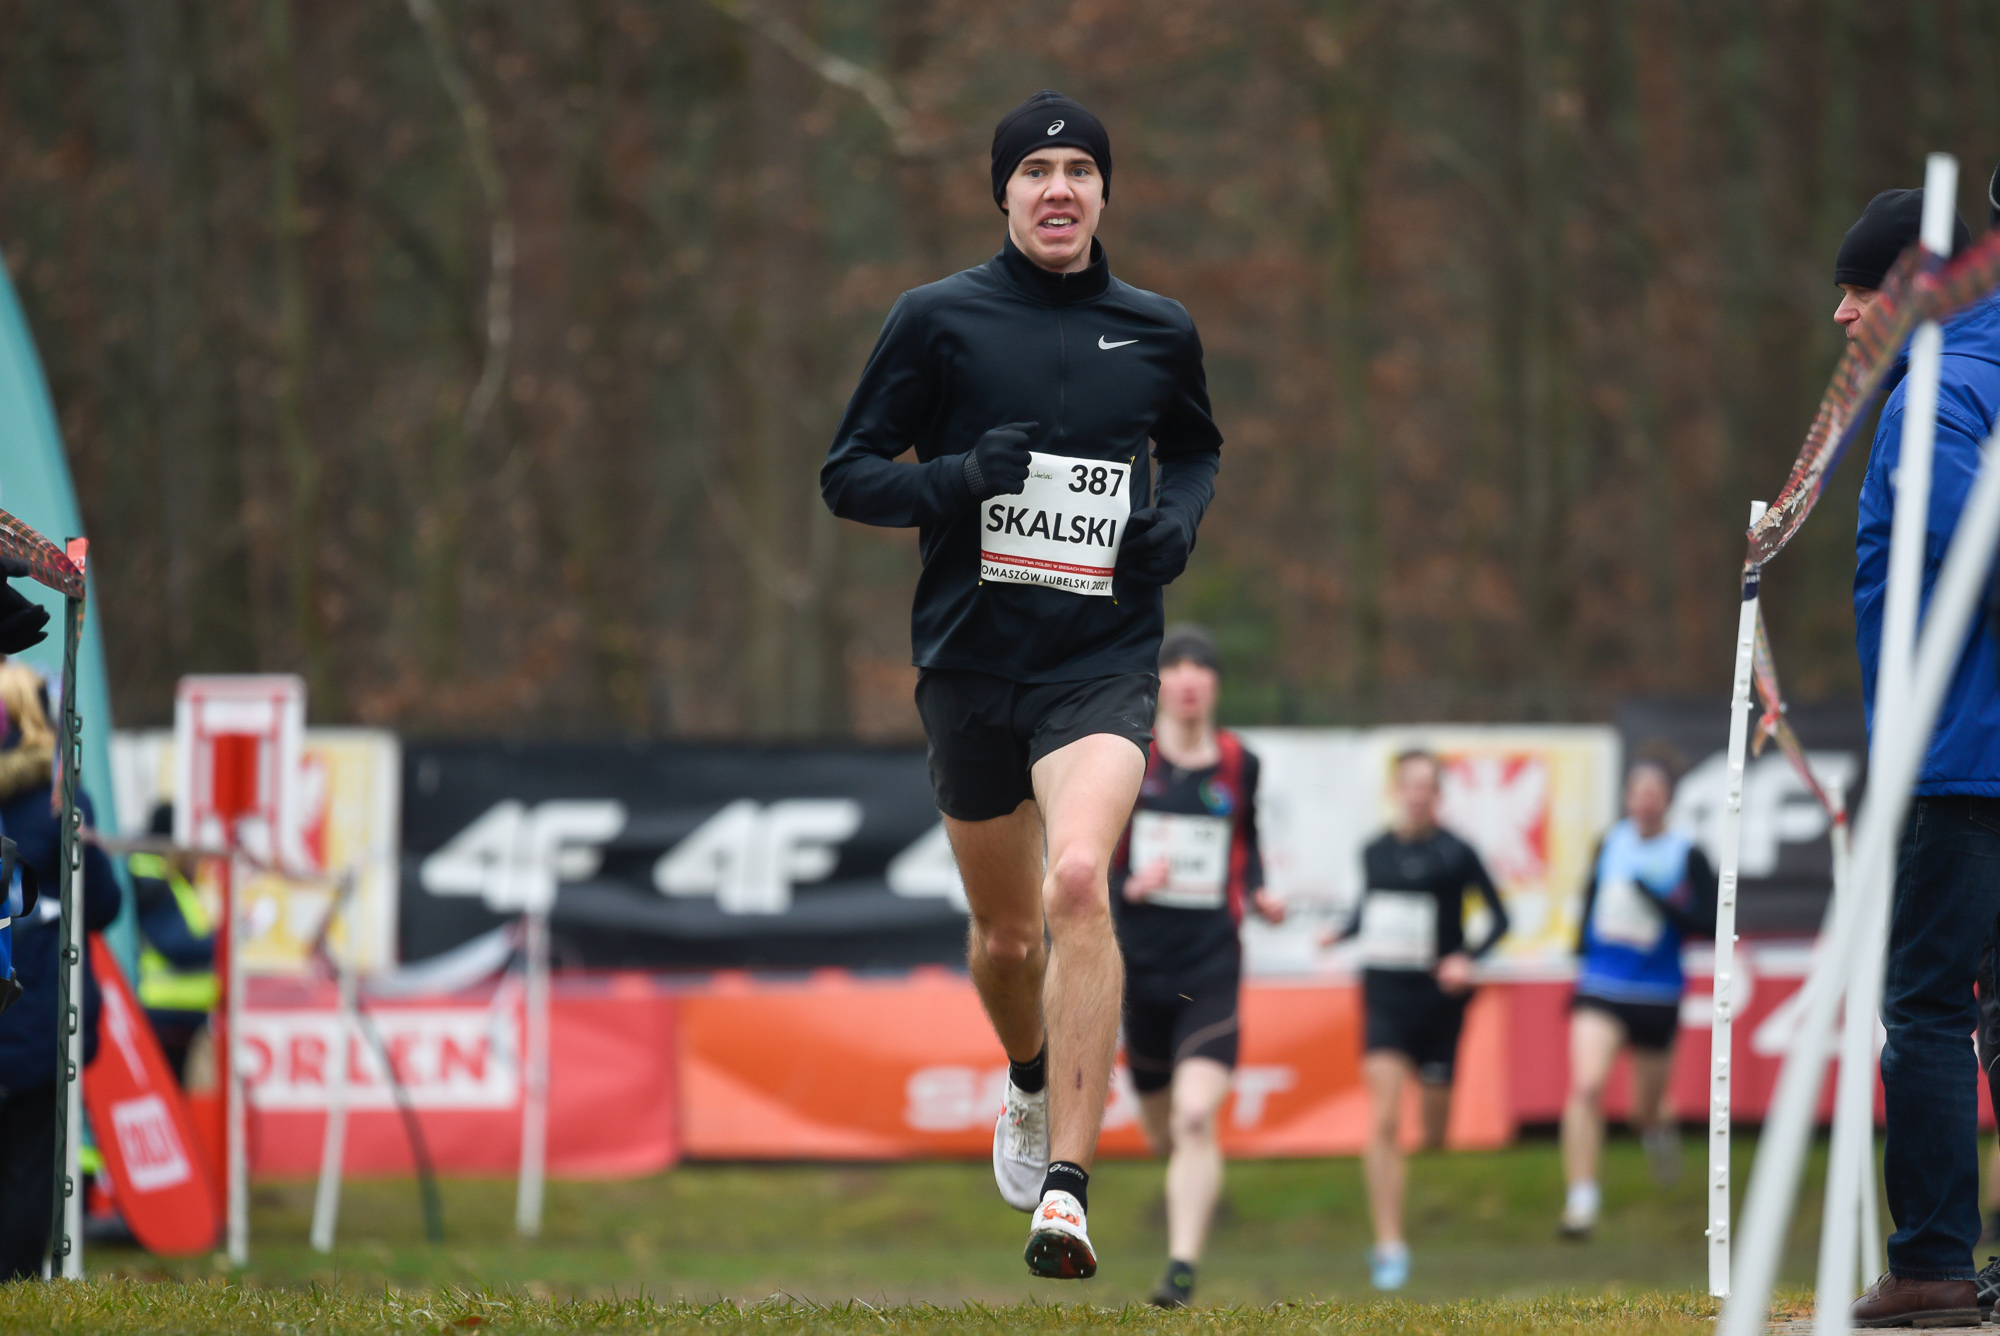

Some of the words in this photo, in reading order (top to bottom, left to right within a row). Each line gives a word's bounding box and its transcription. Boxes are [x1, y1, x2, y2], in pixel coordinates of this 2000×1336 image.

[1068, 464, 1124, 497] 387
[985, 503, 1118, 548] SKALSKI
[981, 564, 1042, 582] OMASZÓW
[1043, 574, 1090, 590] LUBELSKI
[1091, 580, 1109, 591] 2021
[419, 799, 626, 911] 4F
[652, 799, 862, 914] 4F
[886, 810, 970, 914] 4
